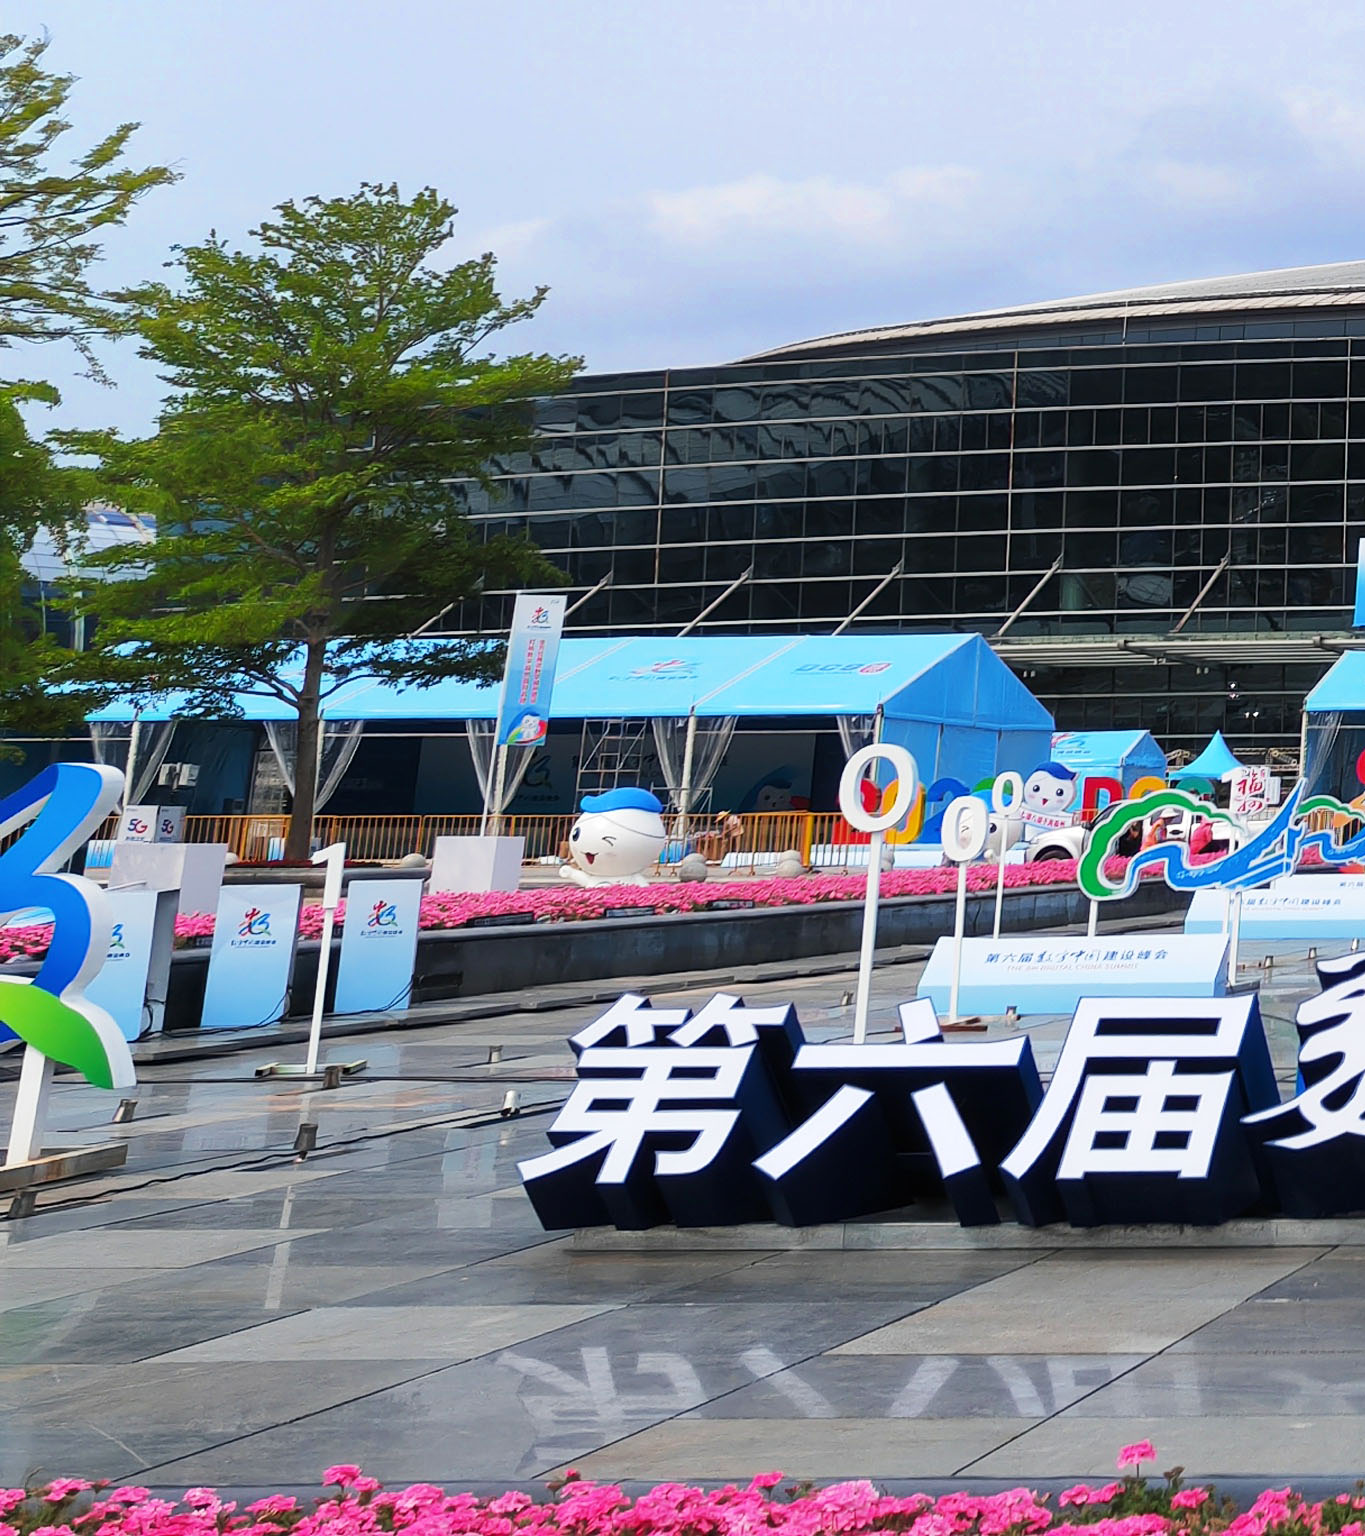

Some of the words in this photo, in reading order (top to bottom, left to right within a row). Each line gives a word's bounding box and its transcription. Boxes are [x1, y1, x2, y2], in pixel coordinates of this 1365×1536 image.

[127, 818, 149, 834] 5G
[984, 949, 1169, 964] 第六届数字中国建设峰会
